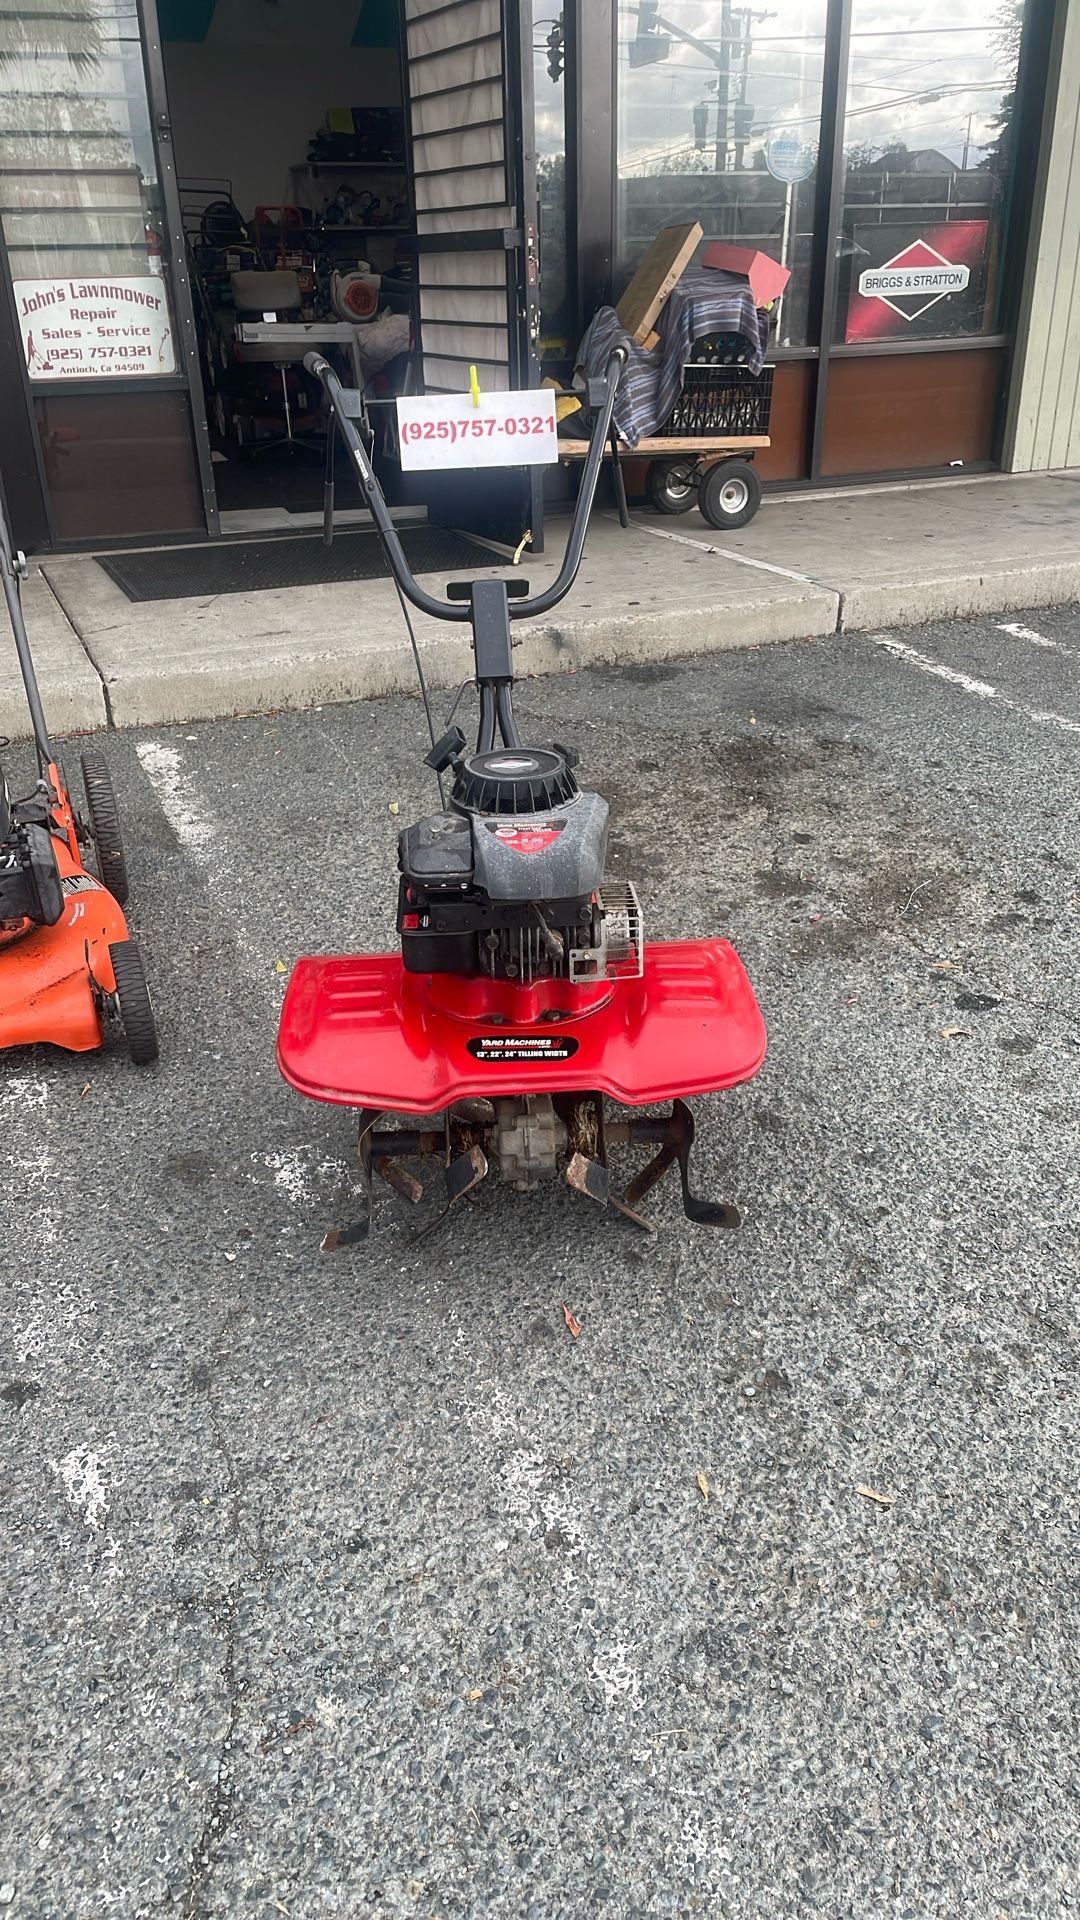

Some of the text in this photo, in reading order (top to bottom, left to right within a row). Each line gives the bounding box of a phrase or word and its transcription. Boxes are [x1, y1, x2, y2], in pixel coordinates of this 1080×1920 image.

[865, 273, 963, 289] BRIGGS & STRATTON
[22, 282, 162, 316] John's Lawnmower
[69, 307, 117, 322] Repair
[41, 328, 82, 340] Sales
[97, 325, 151, 338] Service
[46, 345, 152, 362] (925) 757-0321
[60, 363, 145, 375] Antioch, Ca 94509
[401, 415, 555, 445] (925)757-0321
[504, 1038, 552, 1046] MACHINES
